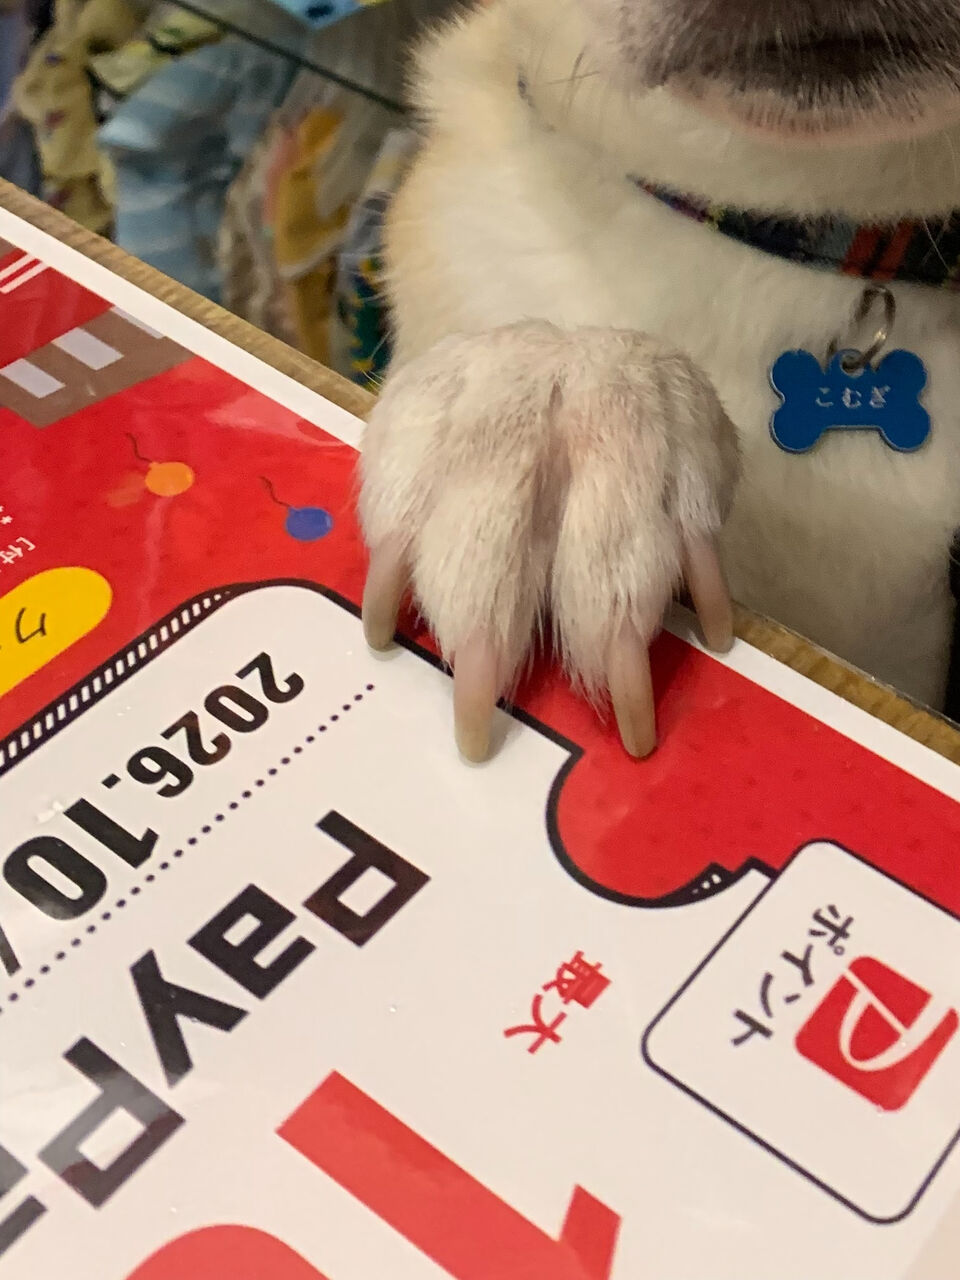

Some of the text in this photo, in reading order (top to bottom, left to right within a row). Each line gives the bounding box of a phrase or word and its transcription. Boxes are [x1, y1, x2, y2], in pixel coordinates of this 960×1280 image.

[815, 385, 892, 409] こむぎ
[0, 809, 432, 1256] PayP
[502, 950, 613, 1055] 最大
[731, 904, 854, 1047] ポイント
